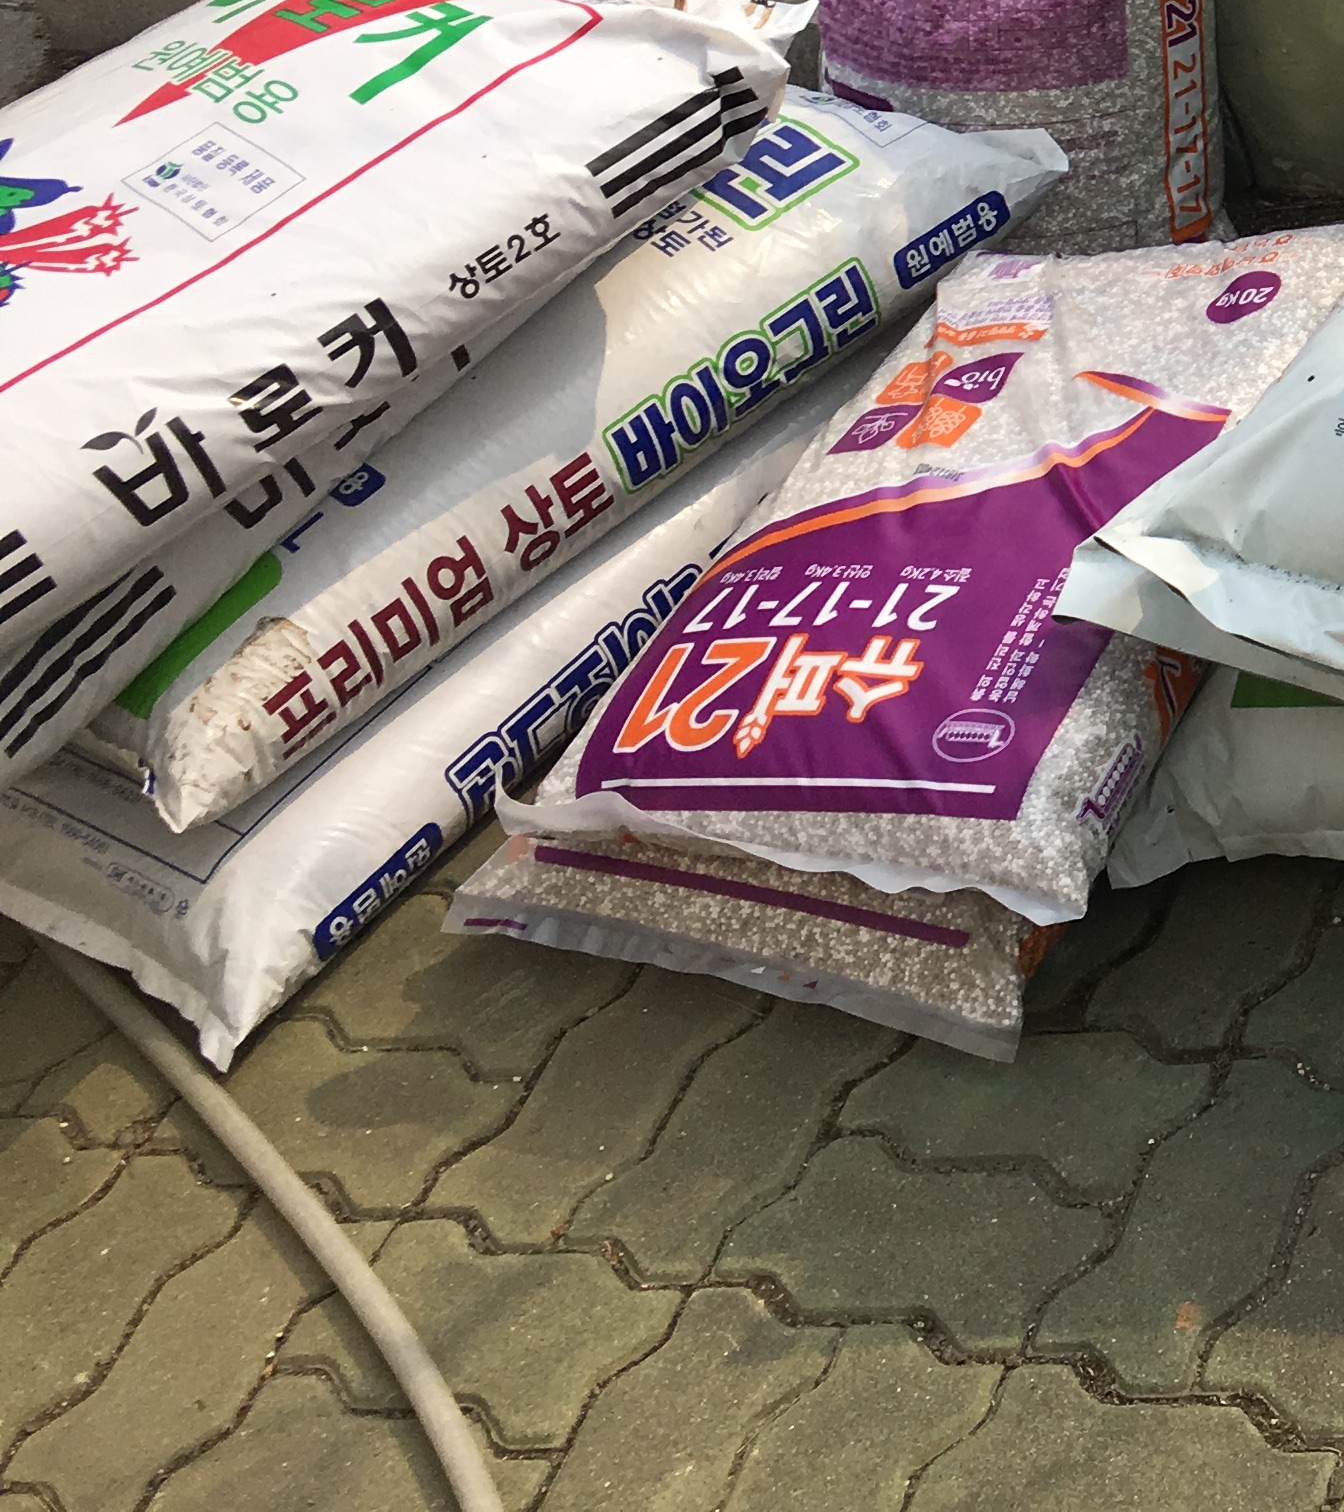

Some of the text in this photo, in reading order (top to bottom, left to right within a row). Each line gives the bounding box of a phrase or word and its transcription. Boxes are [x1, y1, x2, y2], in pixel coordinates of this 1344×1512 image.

[132, 40, 299, 124] 원예범용
[1172, 54, 1203, 230] 21-17-17
[447, 211, 562, 301] 상토2호
[904, 201, 999, 278] 원예범용
[1215, 285, 1275, 308] 20Kg
[91, 297, 418, 527] 바로커
[964, 366, 1006, 391] bio
[262, 535, 495, 761] 프리미엄
[499, 452, 615, 573] 상토
[608, 264, 878, 491] 바이오그린
[684, 582, 962, 634] 21-17-17
[616, 633, 926, 759] 슈퍼21
[329, 836, 432, 947] 원예범용
